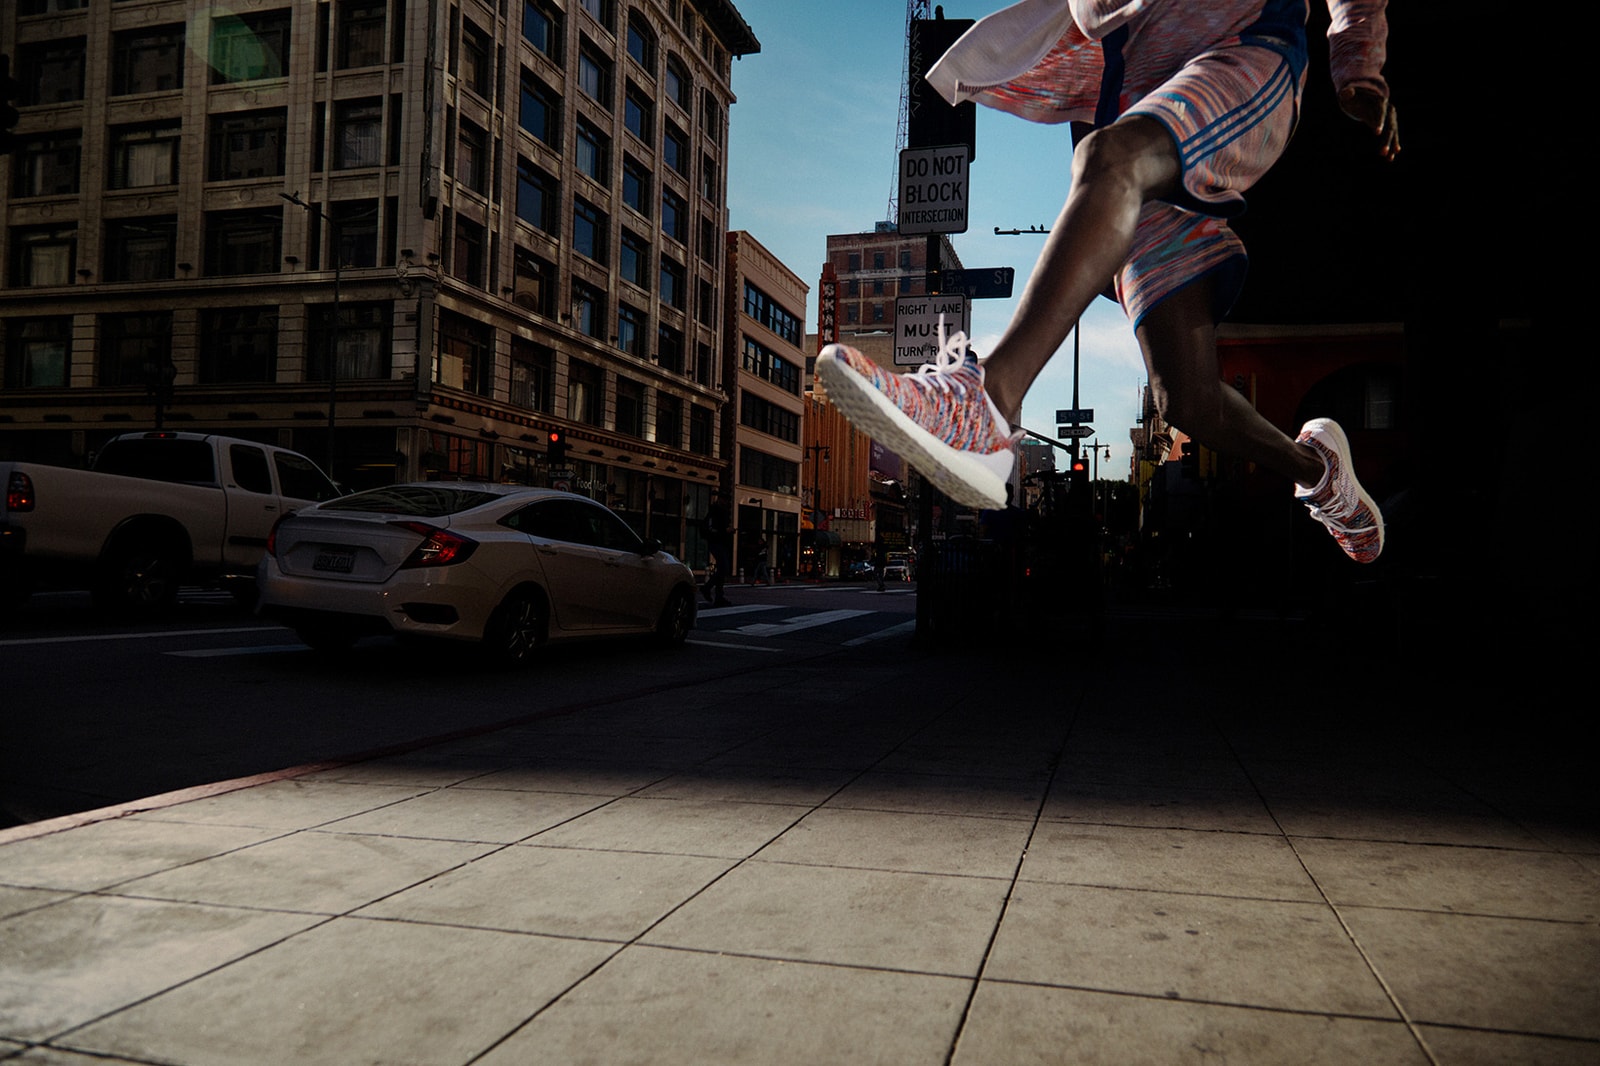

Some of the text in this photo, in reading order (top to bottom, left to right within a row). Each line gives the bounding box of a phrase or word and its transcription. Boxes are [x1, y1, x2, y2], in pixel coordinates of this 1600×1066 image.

[906, 155, 964, 178] DO NOT
[906, 182, 963, 204] BLOCK
[901, 208, 964, 225] INTERSECTION
[993, 270, 1009, 285] St
[898, 303, 961, 315] RIGHT LANE
[904, 322, 954, 337] MUST
[897, 346, 923, 357] TURN
[576, 477, 609, 492] Food Mart
